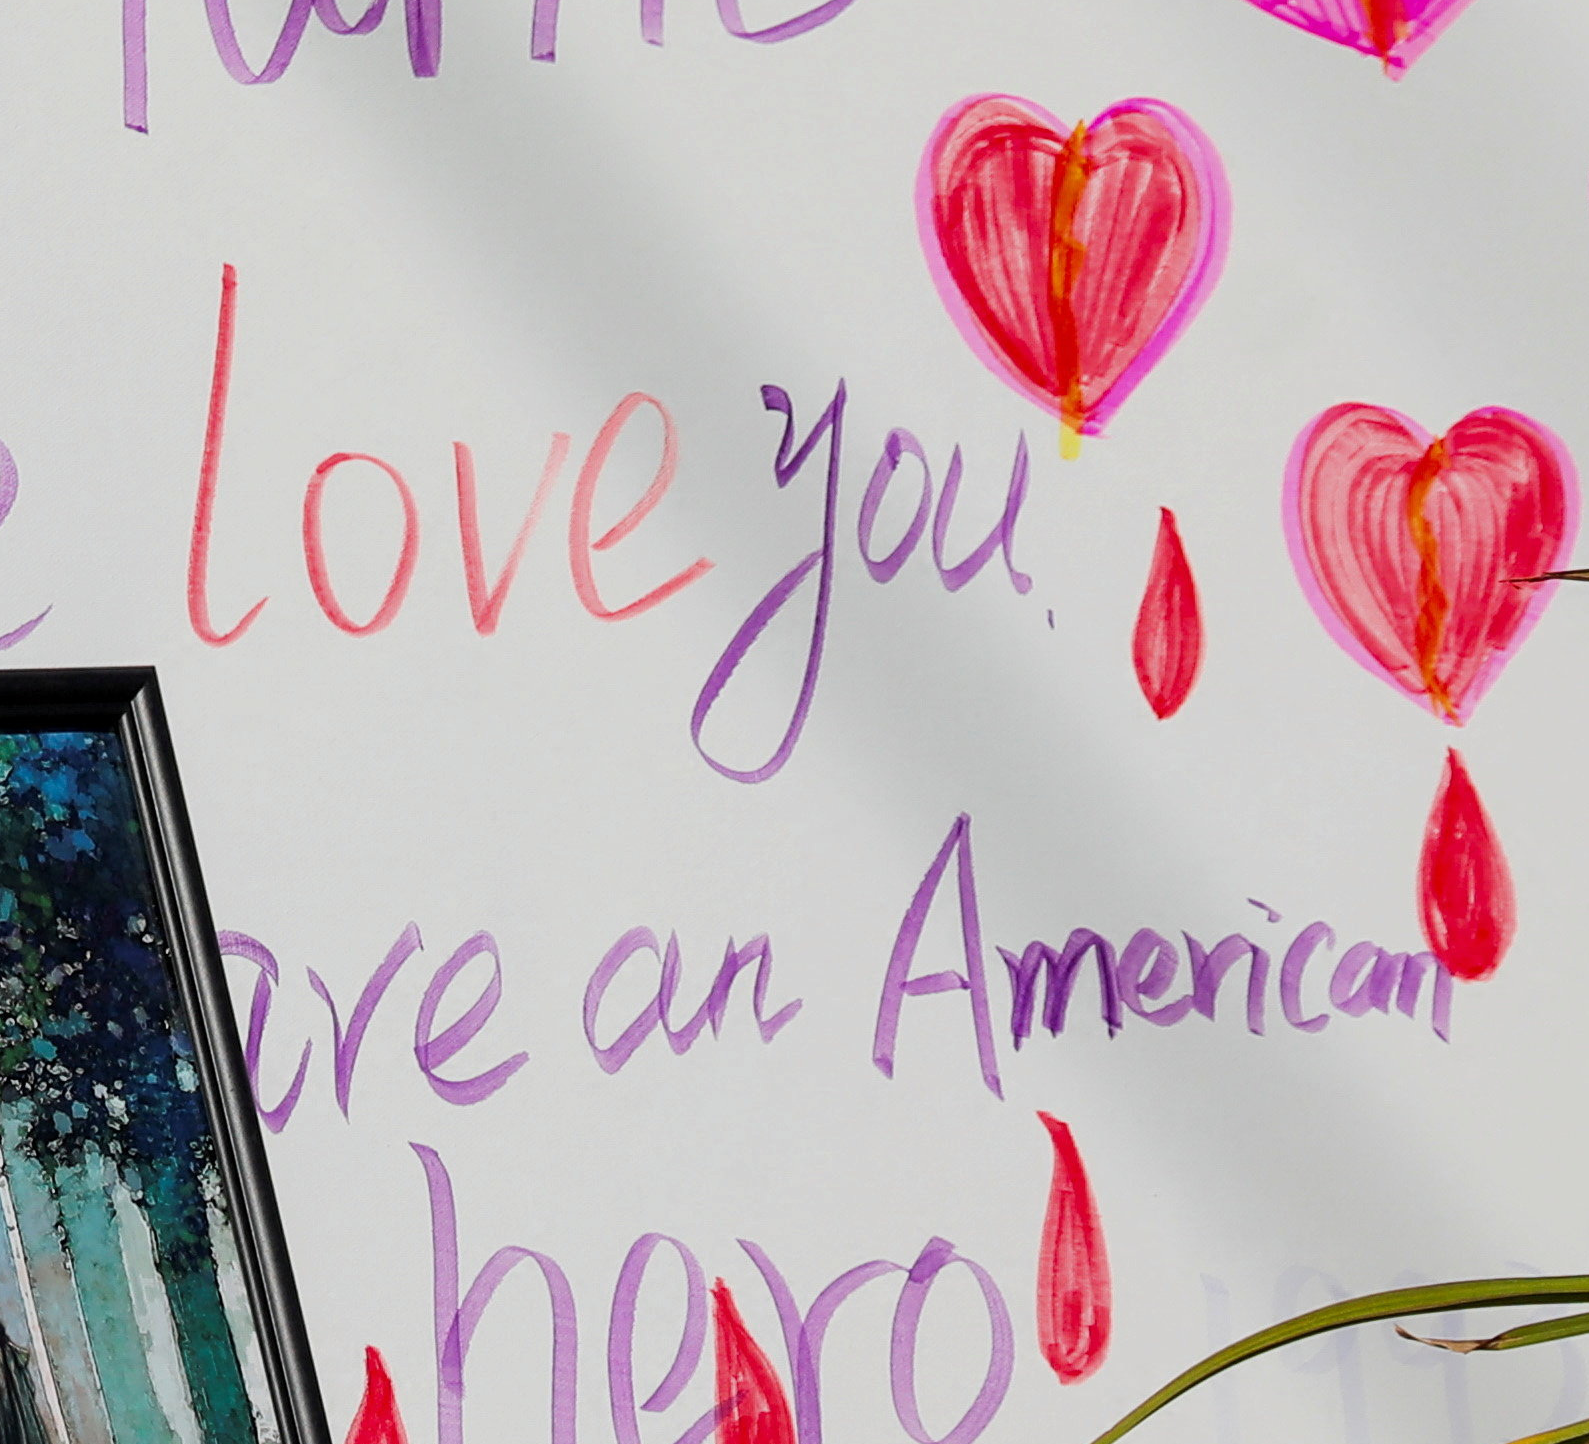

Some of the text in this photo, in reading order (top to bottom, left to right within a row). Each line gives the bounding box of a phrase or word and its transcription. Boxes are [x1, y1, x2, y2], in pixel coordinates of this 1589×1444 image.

[185, 261, 716, 649] love
[582, 924, 805, 1075] an
[871, 811, 1454, 1102] American
